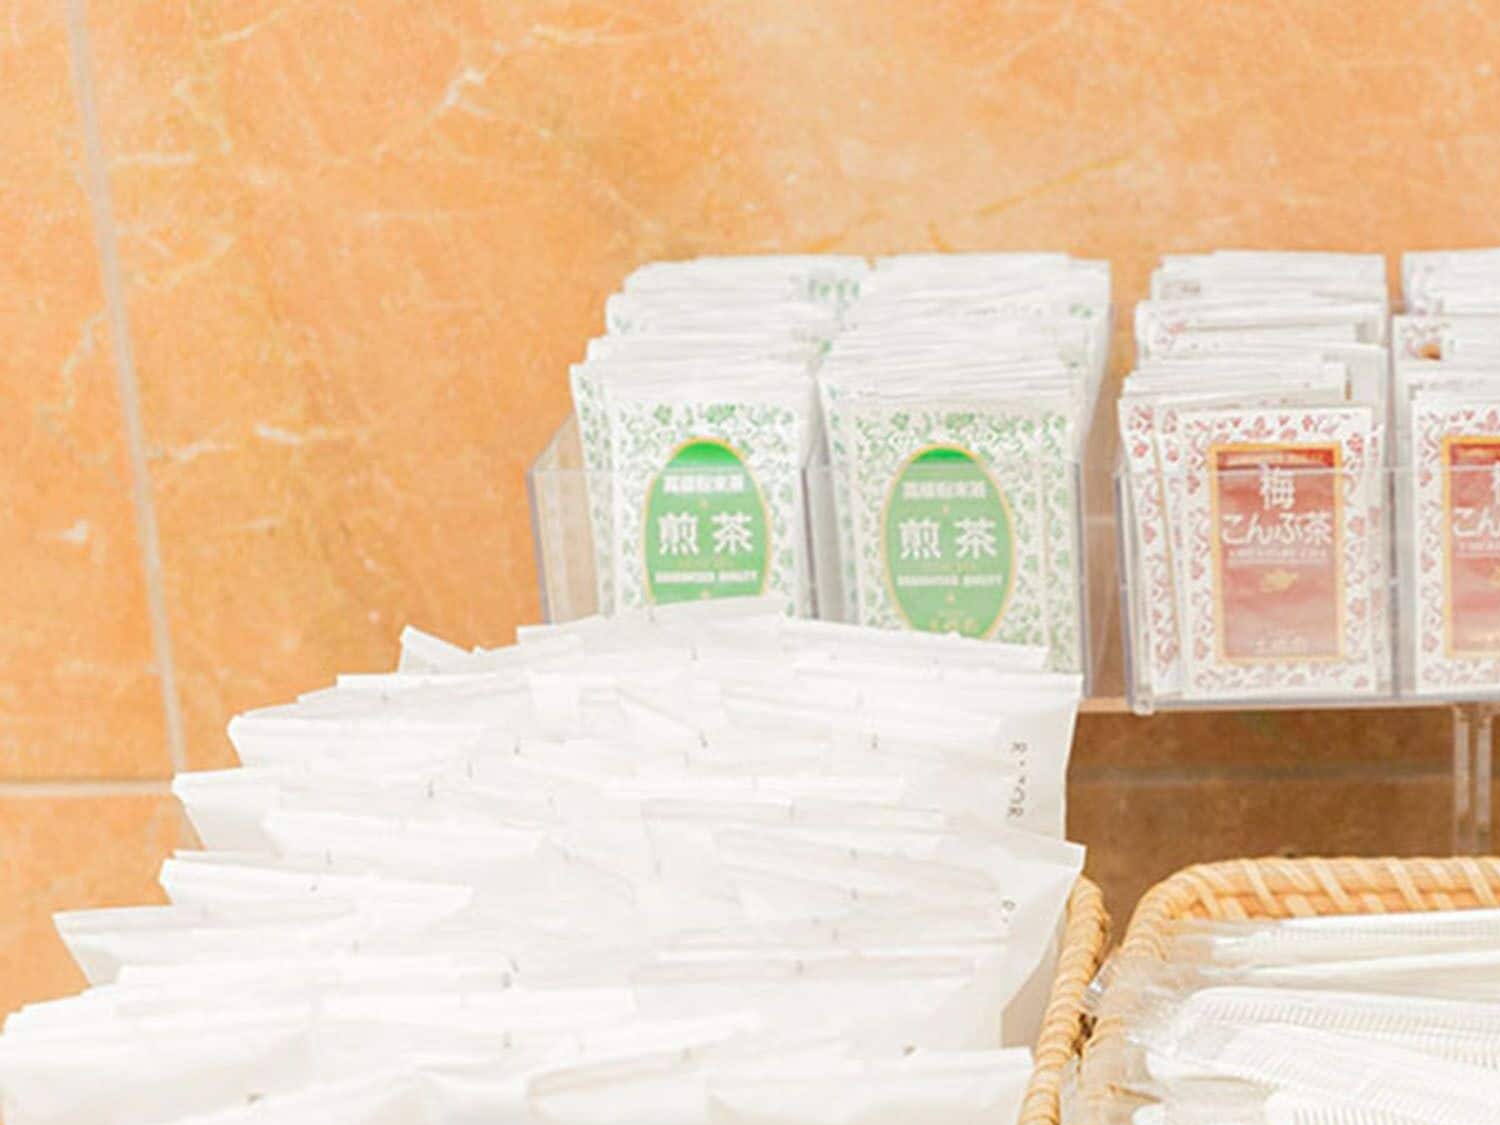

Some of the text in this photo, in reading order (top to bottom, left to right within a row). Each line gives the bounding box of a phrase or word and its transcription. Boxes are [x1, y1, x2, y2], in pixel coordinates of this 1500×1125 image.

[1258, 463, 1296, 510] 梅
[657, 512, 753, 556] 煎茶
[899, 517, 997, 559] 煎茶
[1221, 511, 1333, 545] こんぶ茶
[1007, 741, 1027, 817] ROR
